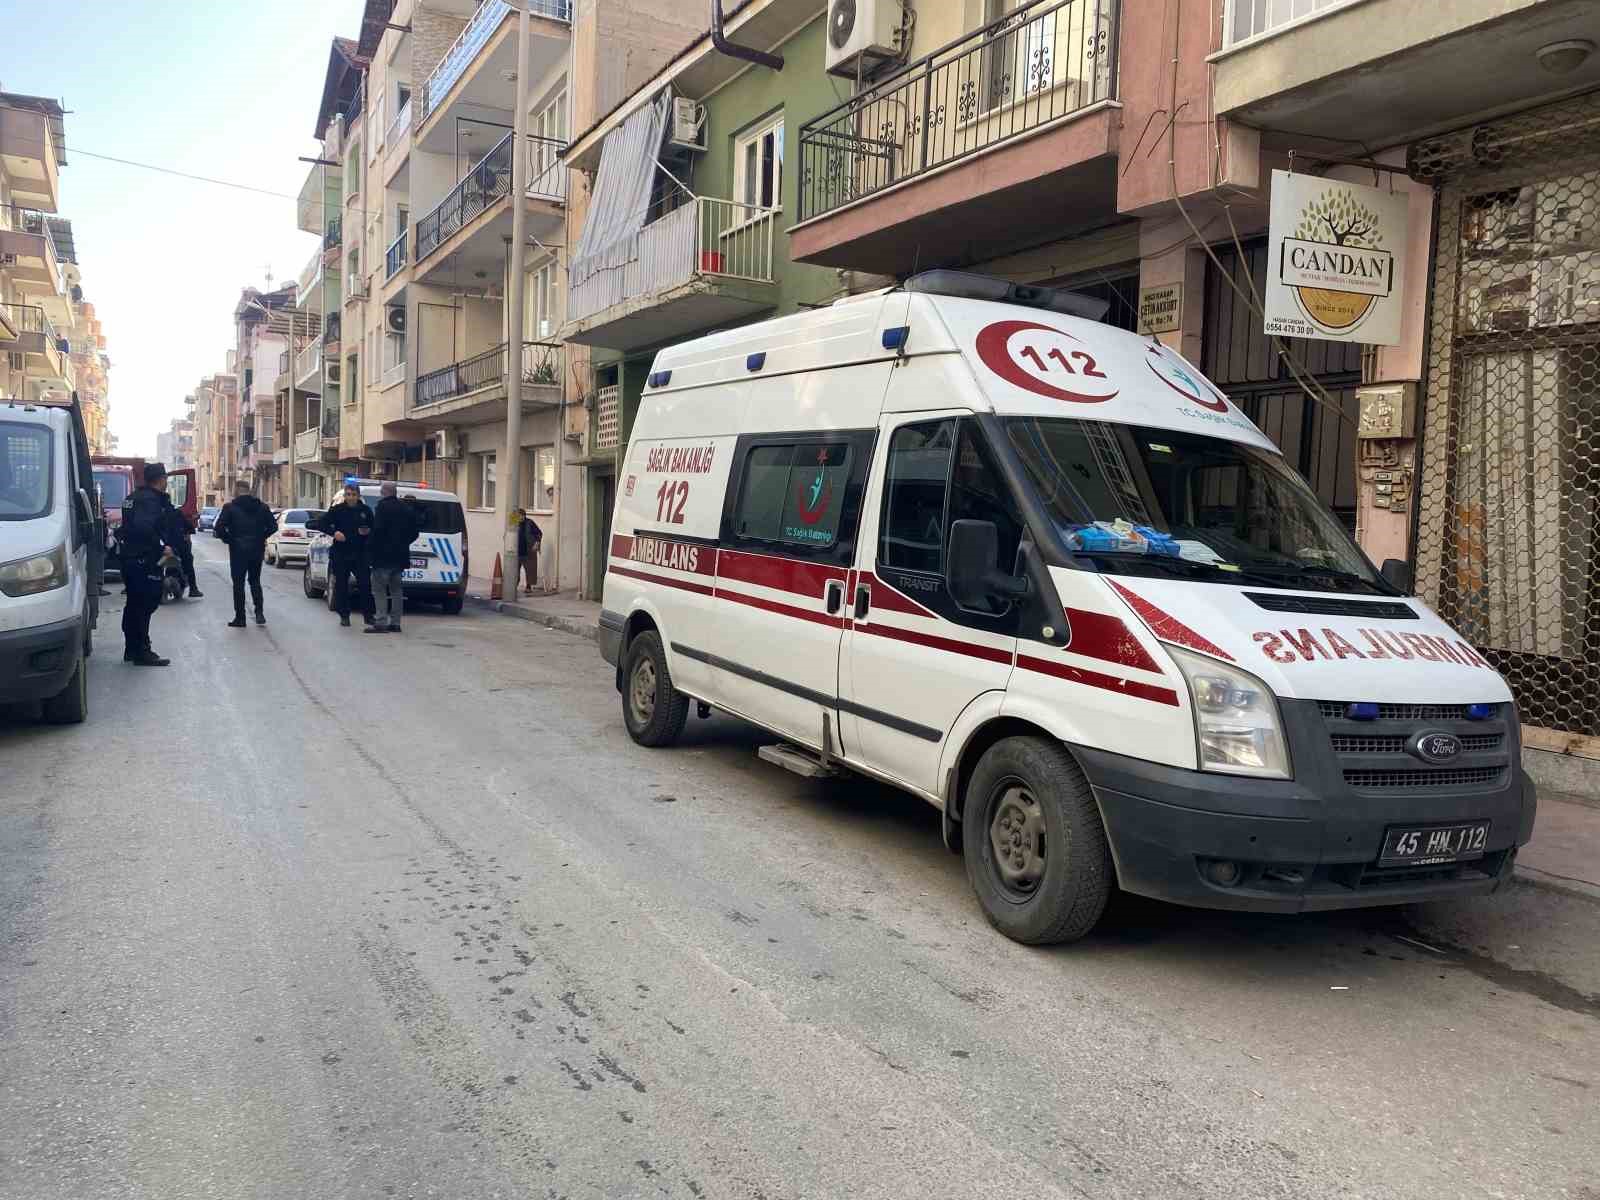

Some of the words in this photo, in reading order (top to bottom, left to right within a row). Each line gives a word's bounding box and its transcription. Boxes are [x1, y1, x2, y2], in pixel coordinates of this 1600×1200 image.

[1291, 247, 1384, 279] CANDAN
[1266, 322, 1282, 331] 0554
[1020, 345, 1108, 379] 112
[646, 443, 672, 473] SAĞLIK
[656, 480, 690, 525] 112
[629, 535, 699, 572] AMBULANS
[900, 576, 940, 592] TRANSIT
[1432, 737, 1455, 754] Ford
[1396, 831, 1422, 855] 45
[1456, 826, 1485, 852] 112
